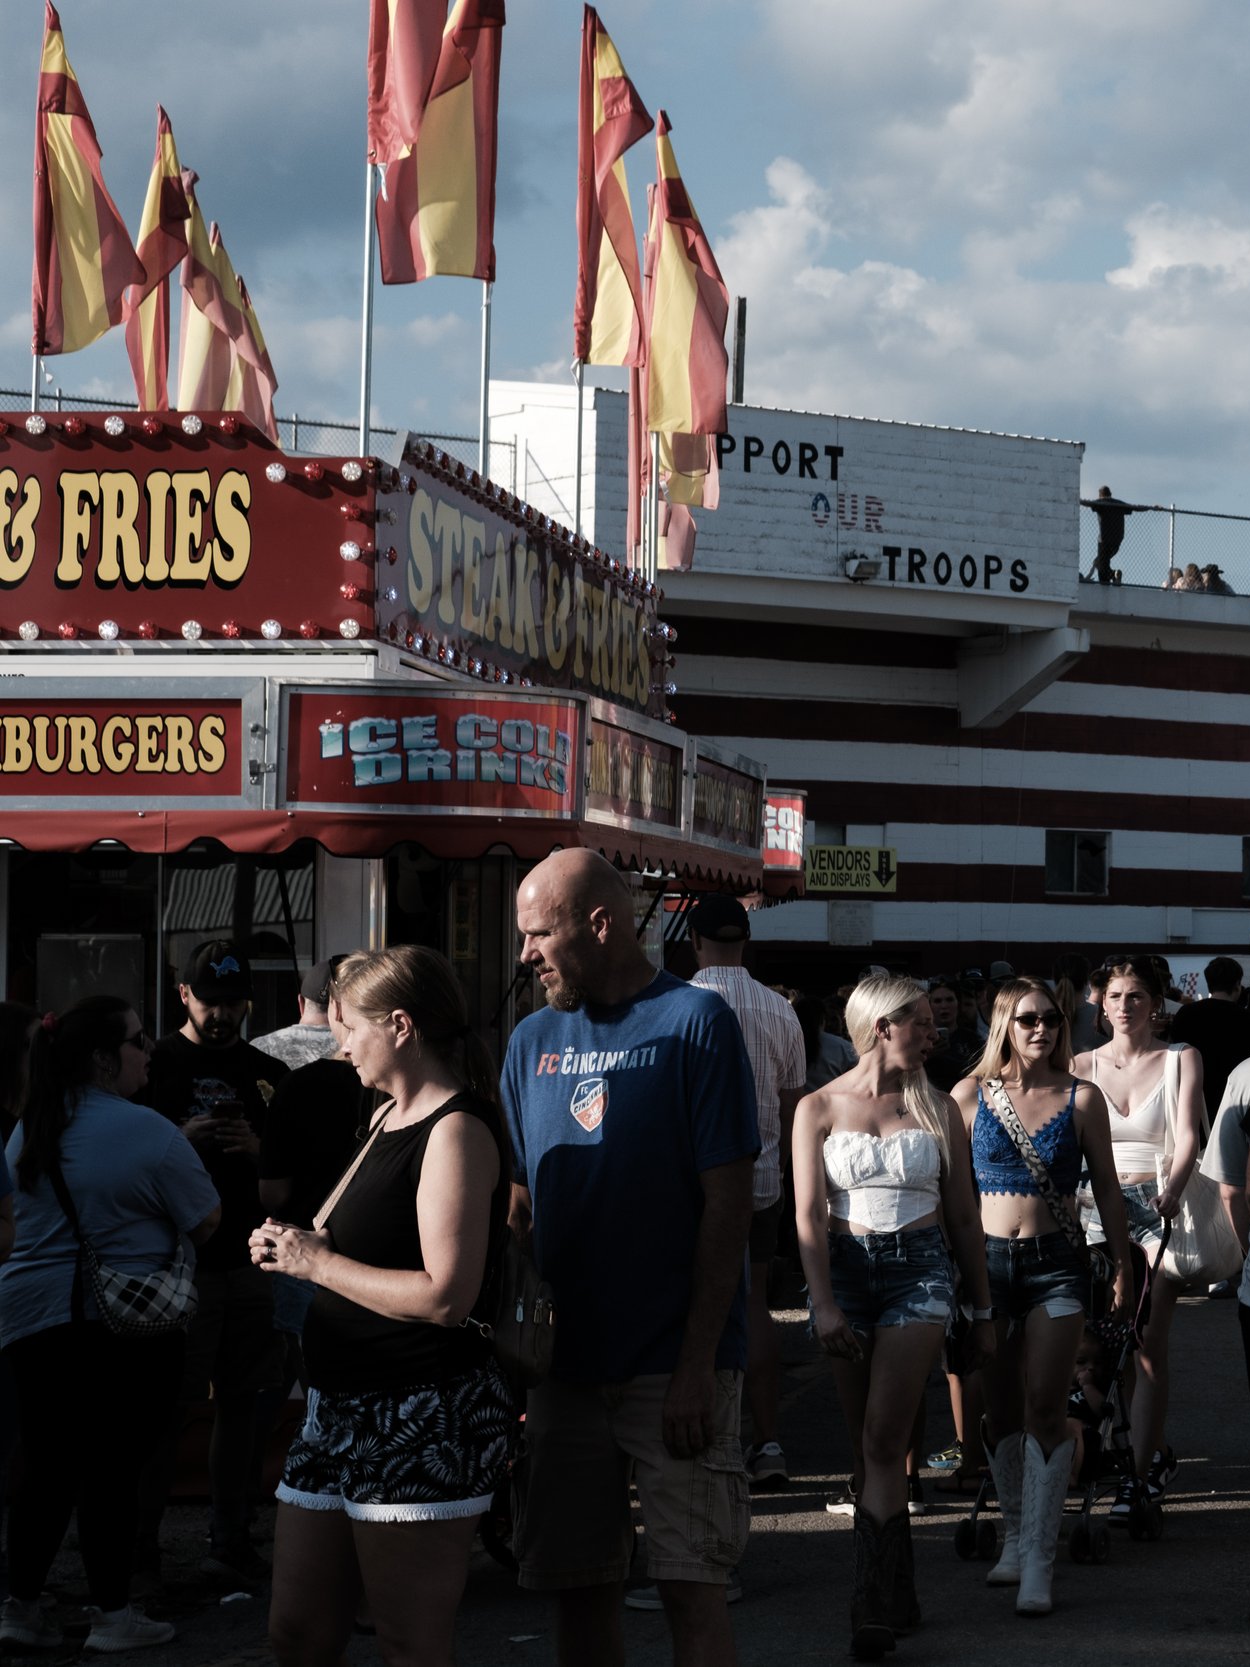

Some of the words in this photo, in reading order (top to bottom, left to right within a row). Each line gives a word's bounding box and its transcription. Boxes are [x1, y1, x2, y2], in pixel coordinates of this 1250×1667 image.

[718, 433, 844, 480] PPORT
[55, 470, 251, 586] FRIES
[811, 492, 885, 533] OUR
[882, 545, 1029, 593] TROOPS
[408, 488, 539, 660] STEAK
[544, 560, 570, 671] &
[573, 575, 652, 706] FRIES
[0, 714, 227, 777] BURGERS
[456, 713, 571, 766] COLD
[352, 747, 568, 796] DRINKS
[765, 805, 803, 833] COL
[809, 850, 871, 871] VENDORS
[809, 872, 828, 886] AND
[830, 872, 871, 887] DISPLAYS
[536, 1053, 560, 1076] FC
[561, 1046, 657, 1075] CINCINNATI
[580, 1086, 589, 1095] FC
